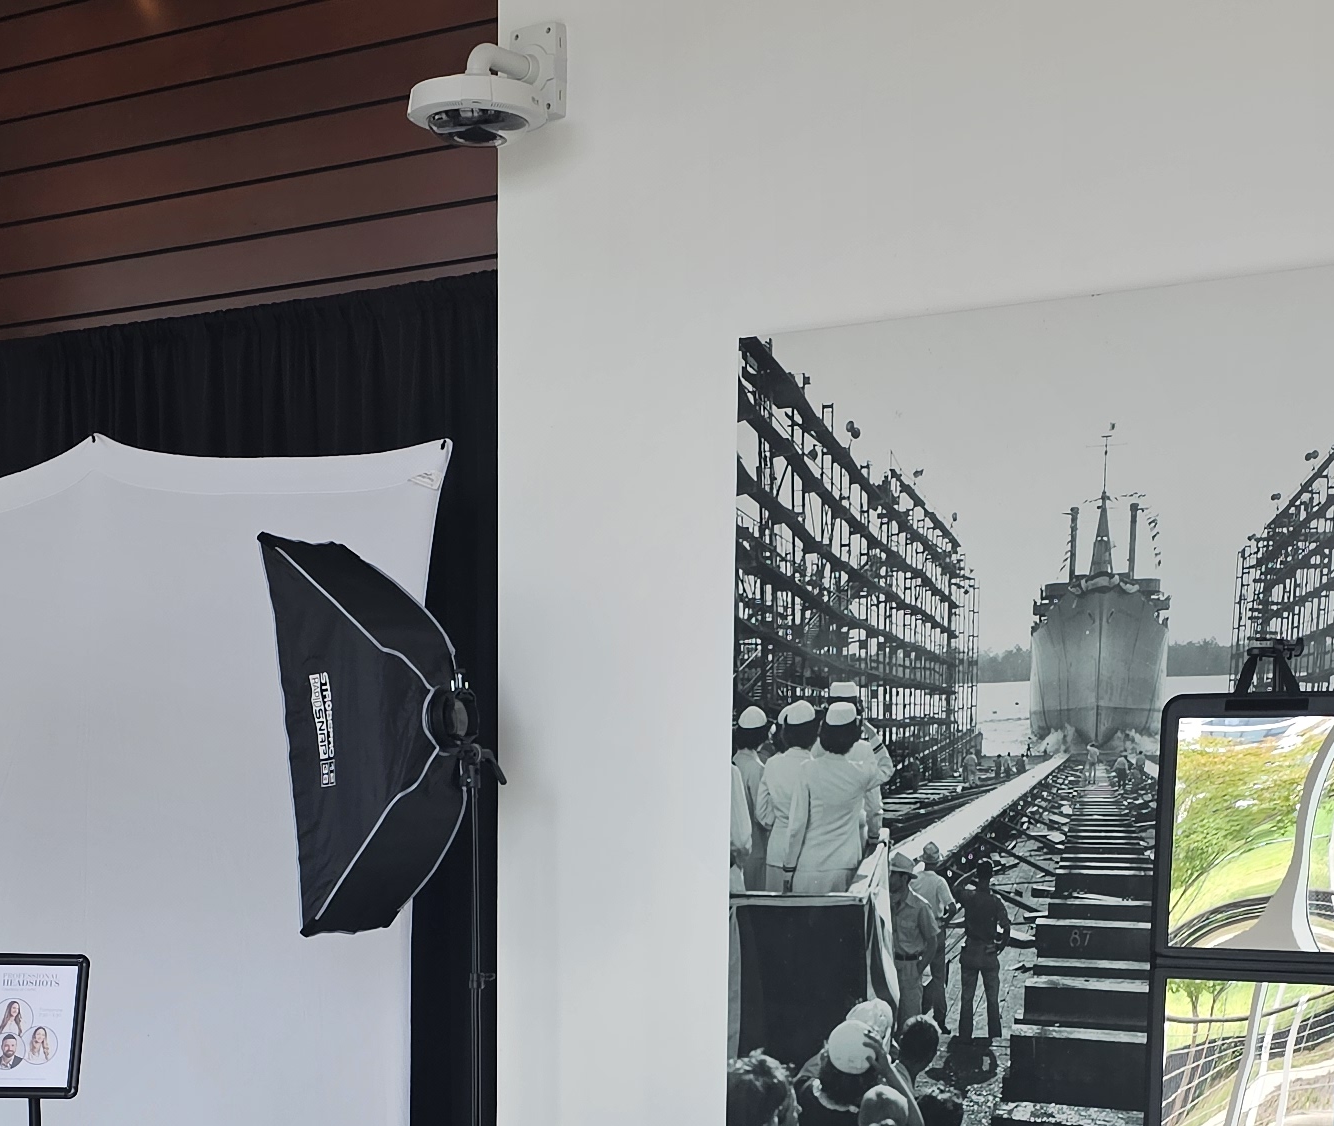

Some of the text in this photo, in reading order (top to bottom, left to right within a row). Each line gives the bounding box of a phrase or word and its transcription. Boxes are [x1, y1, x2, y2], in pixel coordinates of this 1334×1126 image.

[1069, 929, 1092, 947] 87
[3, 972, 59, 980] PROFESSIONAL
[2, 979, 60, 988] HEADSHOTS
